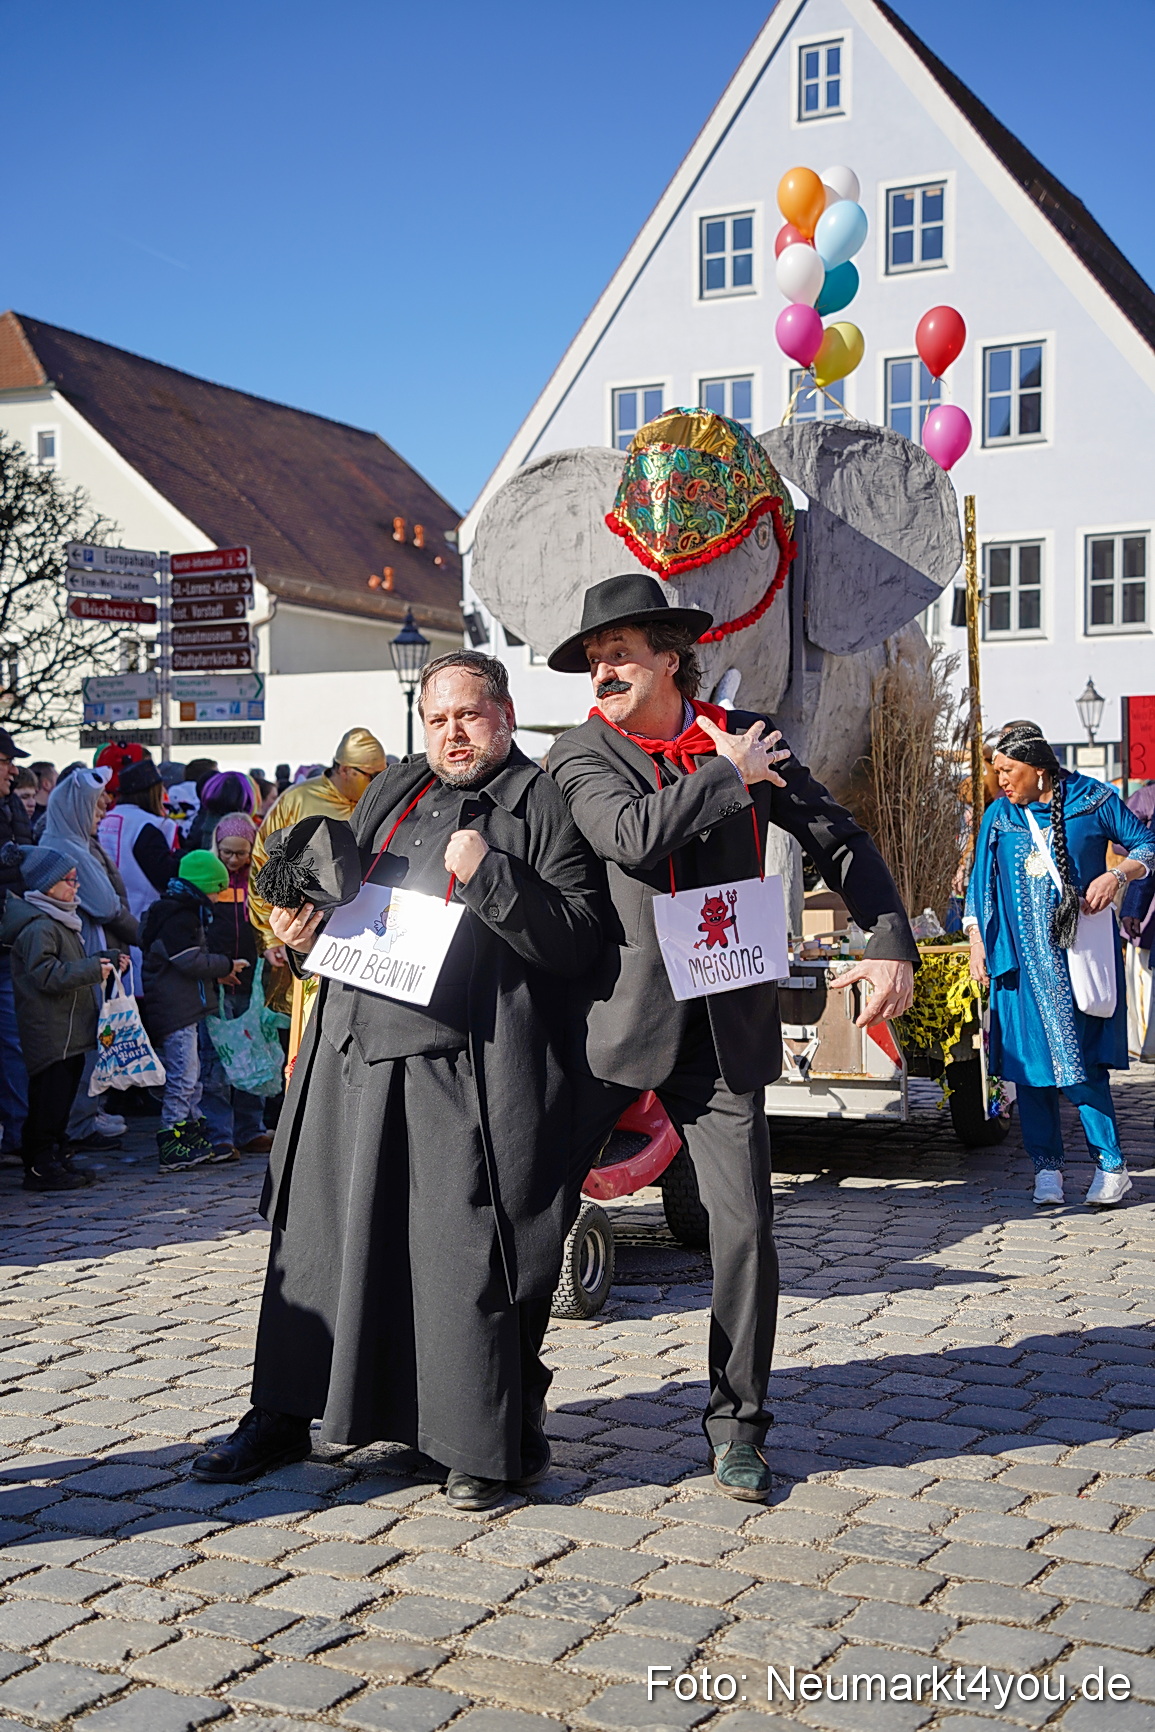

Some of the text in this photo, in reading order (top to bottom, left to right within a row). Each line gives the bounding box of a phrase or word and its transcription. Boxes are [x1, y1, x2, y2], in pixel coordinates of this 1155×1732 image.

[104, 551, 155, 568] Europahalle
[172, 557, 223, 570] Tourist-Information
[81, 577, 140, 591] Eine-Welt-Laden
[173, 581, 239, 596] St.-Lorenz-Kirche
[80, 601, 136, 619] Bücherei
[173, 604, 224, 620] hist. Vorstadt
[173, 631, 233, 644] Heimatmuseum
[174, 652, 237, 669] Stadtpfarrkirche
[179, 729, 255, 742] Pettenkoferplatz
[117, 1047, 148, 1064] Park
